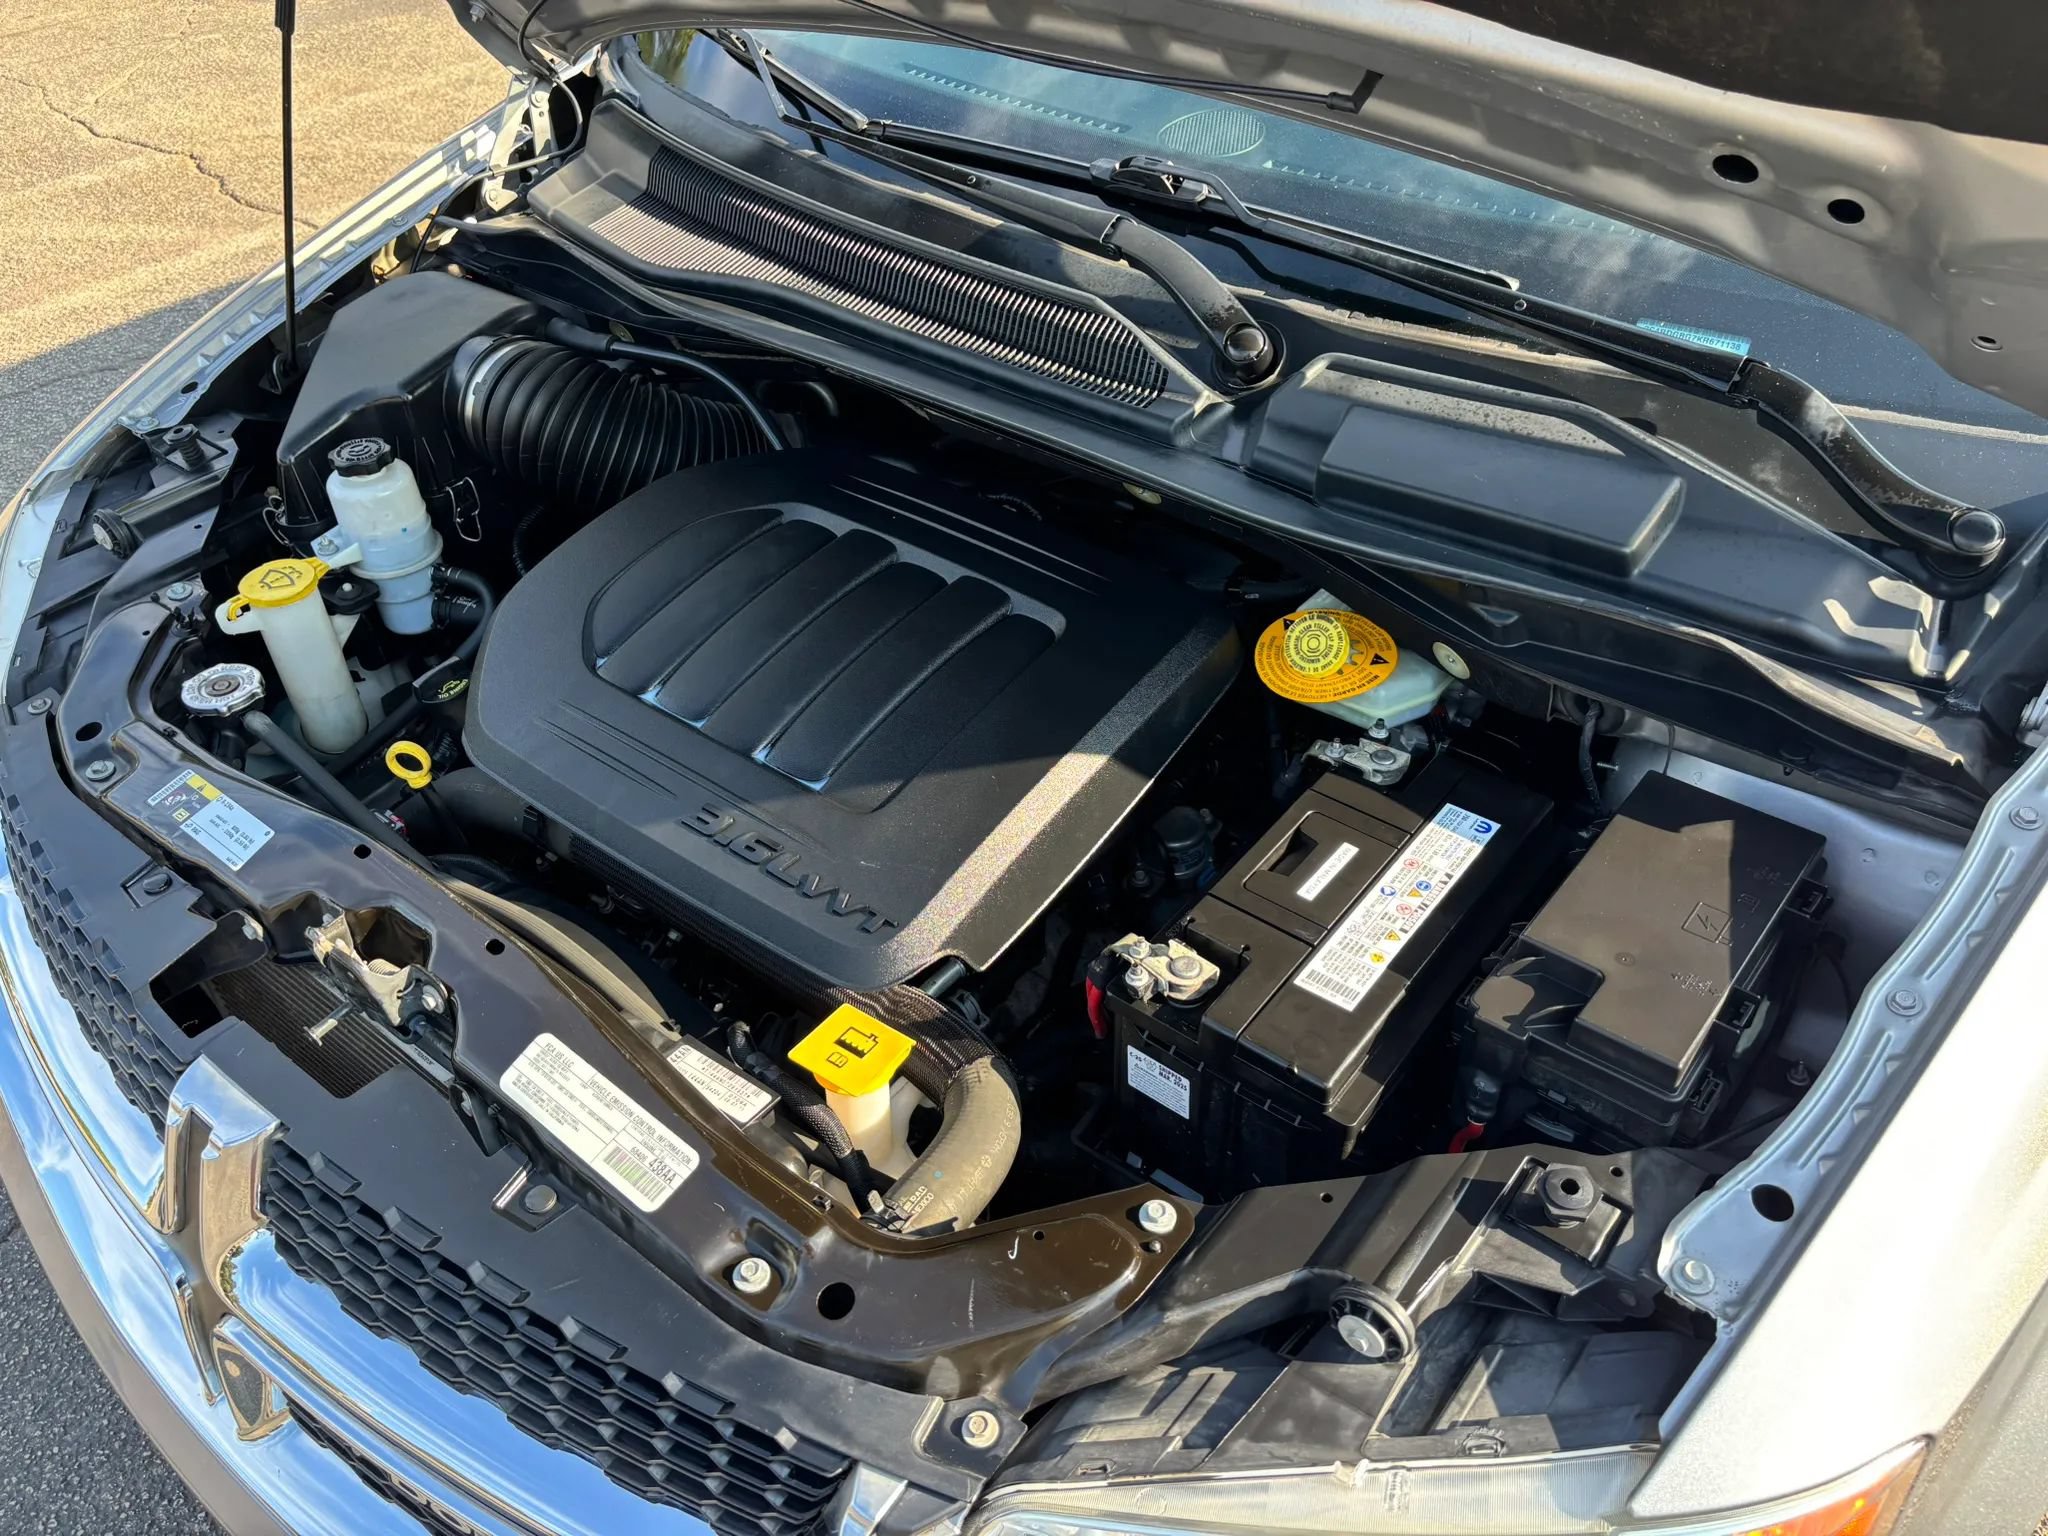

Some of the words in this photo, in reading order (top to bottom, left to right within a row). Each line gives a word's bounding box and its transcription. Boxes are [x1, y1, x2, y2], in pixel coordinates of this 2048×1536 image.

[543, 1041, 557, 1054] FCA
[554, 1050, 565, 1060] US
[560, 1055, 575, 1069] LLC
[588, 1078, 612, 1099] VEHICLE
[608, 1094, 636, 1118] EMISSION
[631, 1113, 658, 1137] CONTROL
[654, 1133, 693, 1165] INFORMATION
[646, 1155, 678, 1185] 438AA
